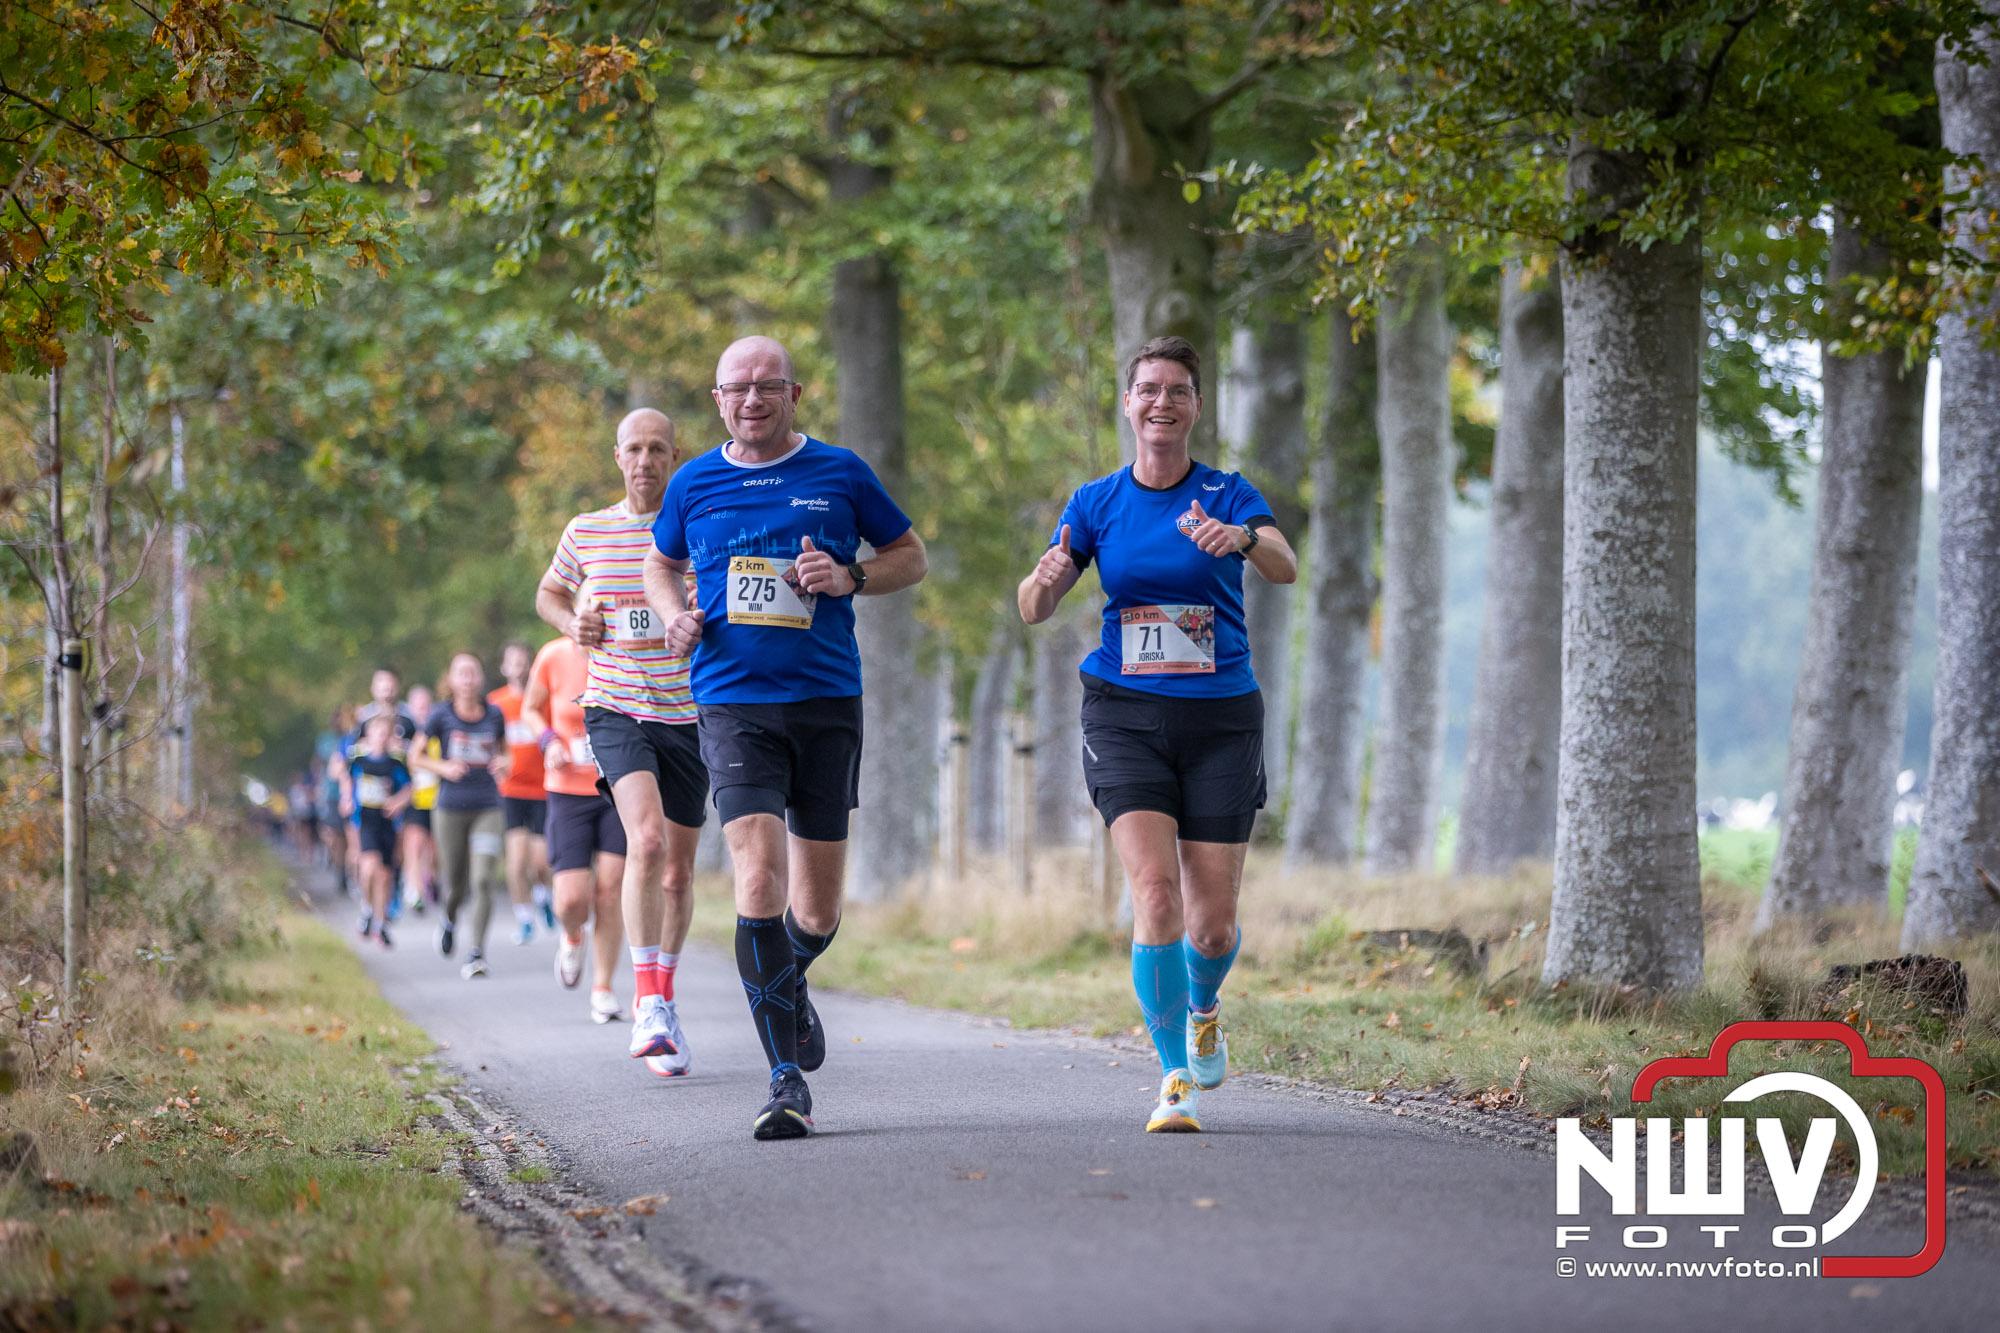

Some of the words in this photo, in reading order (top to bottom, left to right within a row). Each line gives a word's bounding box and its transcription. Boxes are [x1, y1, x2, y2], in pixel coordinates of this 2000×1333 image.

[743, 478, 775, 486] CRAFT
[736, 561, 743, 571] 5
[746, 560, 765, 570] km
[738, 576, 776, 602] 275
[748, 602, 763, 612] WIM
[629, 609, 650, 630] 68
[1143, 610, 1160, 619] km
[1139, 625, 1162, 651] 71
[1138, 652, 1165, 662] JORISKA
